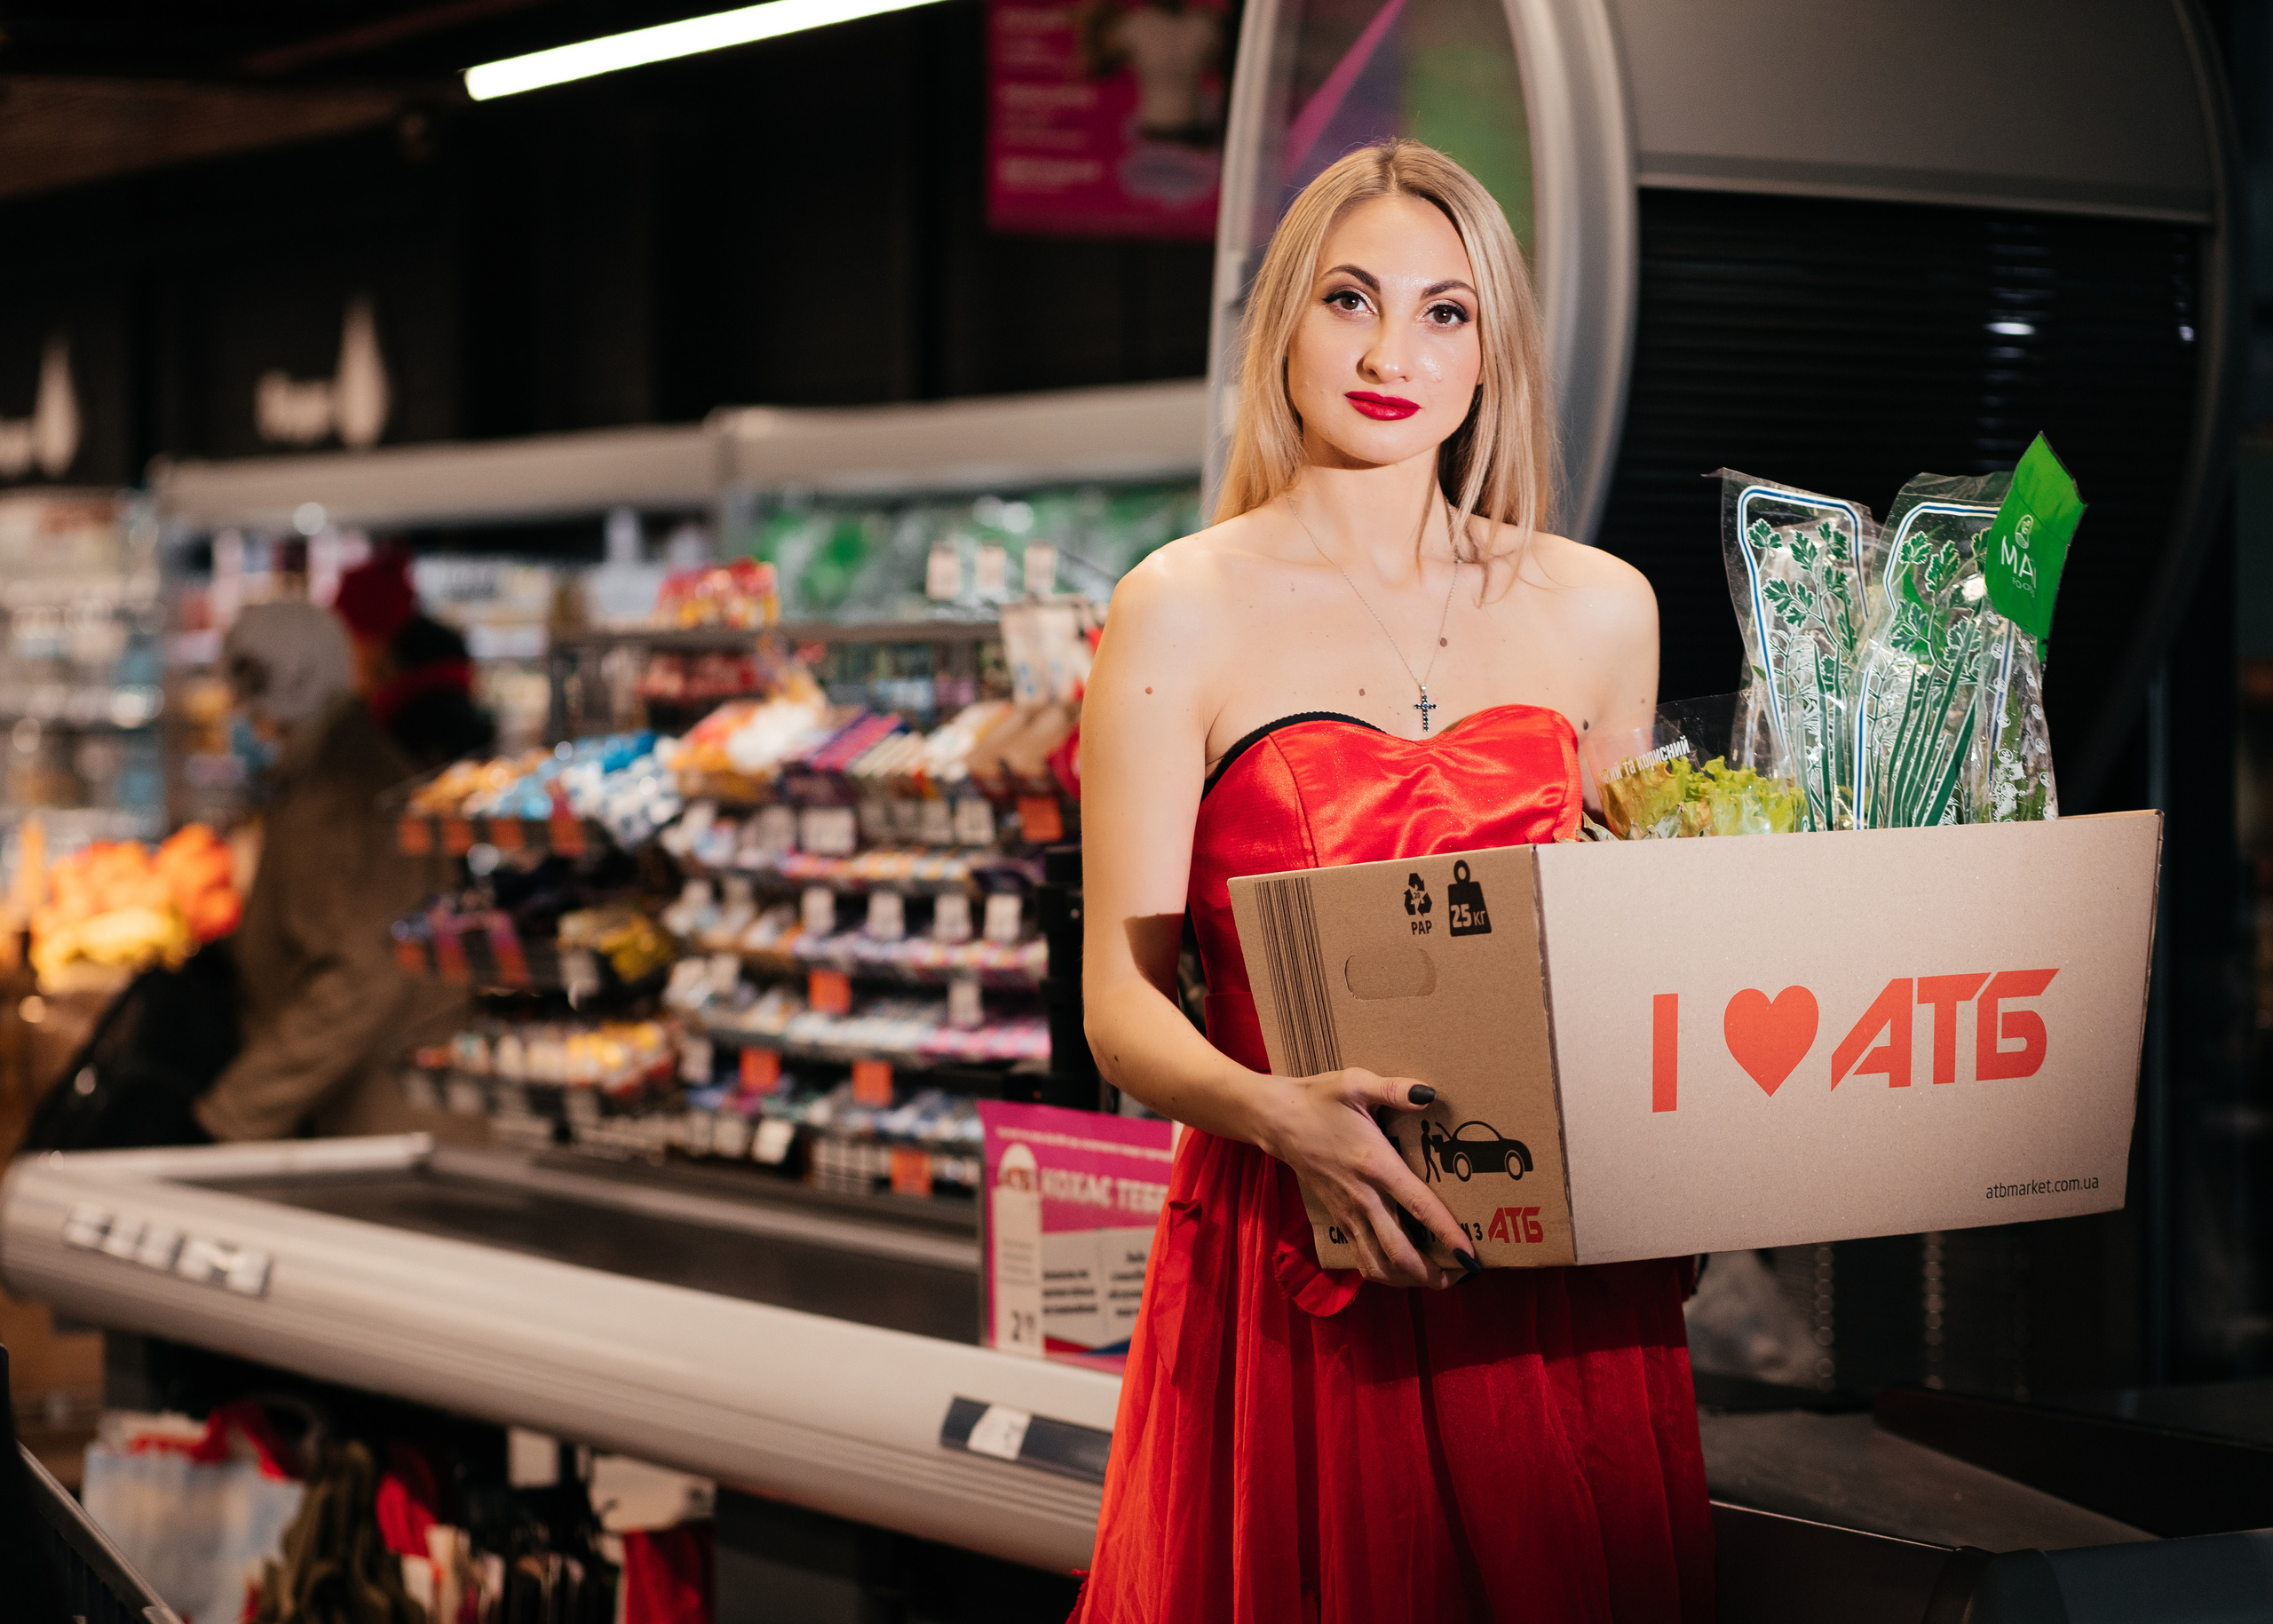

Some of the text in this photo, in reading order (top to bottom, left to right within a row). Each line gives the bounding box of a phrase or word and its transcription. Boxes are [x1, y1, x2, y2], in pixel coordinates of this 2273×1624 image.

[1601, 735, 1691, 784] жий та корисний
[1411, 920, 1432, 935] PAP
[1652, 968, 2061, 1113] I АТБ
[1985, 1176, 2099, 1200] atbmarket.com.ua
[1487, 1206, 1544, 1244] АТБ
